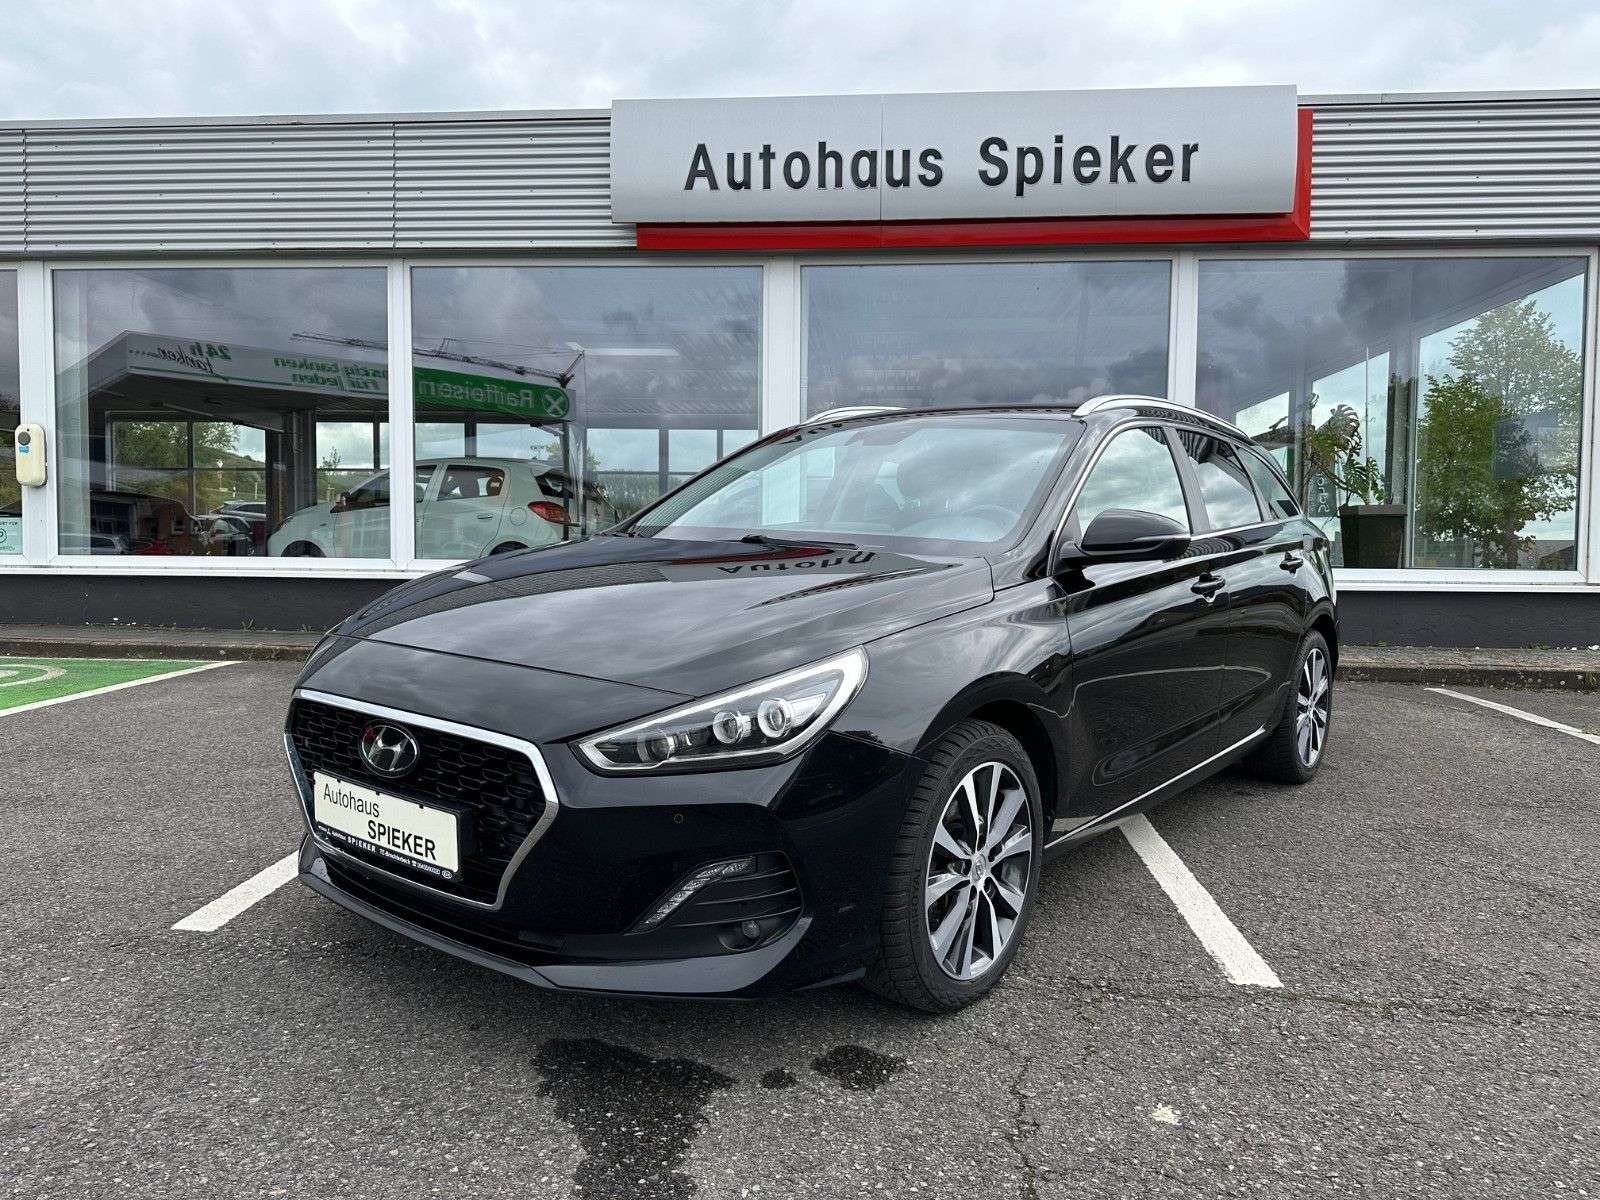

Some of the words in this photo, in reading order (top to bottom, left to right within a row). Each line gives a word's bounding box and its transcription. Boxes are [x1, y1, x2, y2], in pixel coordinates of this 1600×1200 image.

[683, 141, 944, 191] Autohaus
[978, 134, 1199, 198] Spieker
[323, 783, 380, 818] Autohaus
[347, 835, 377, 853] SPIEKER
[367, 819, 437, 861] SPIEKER
